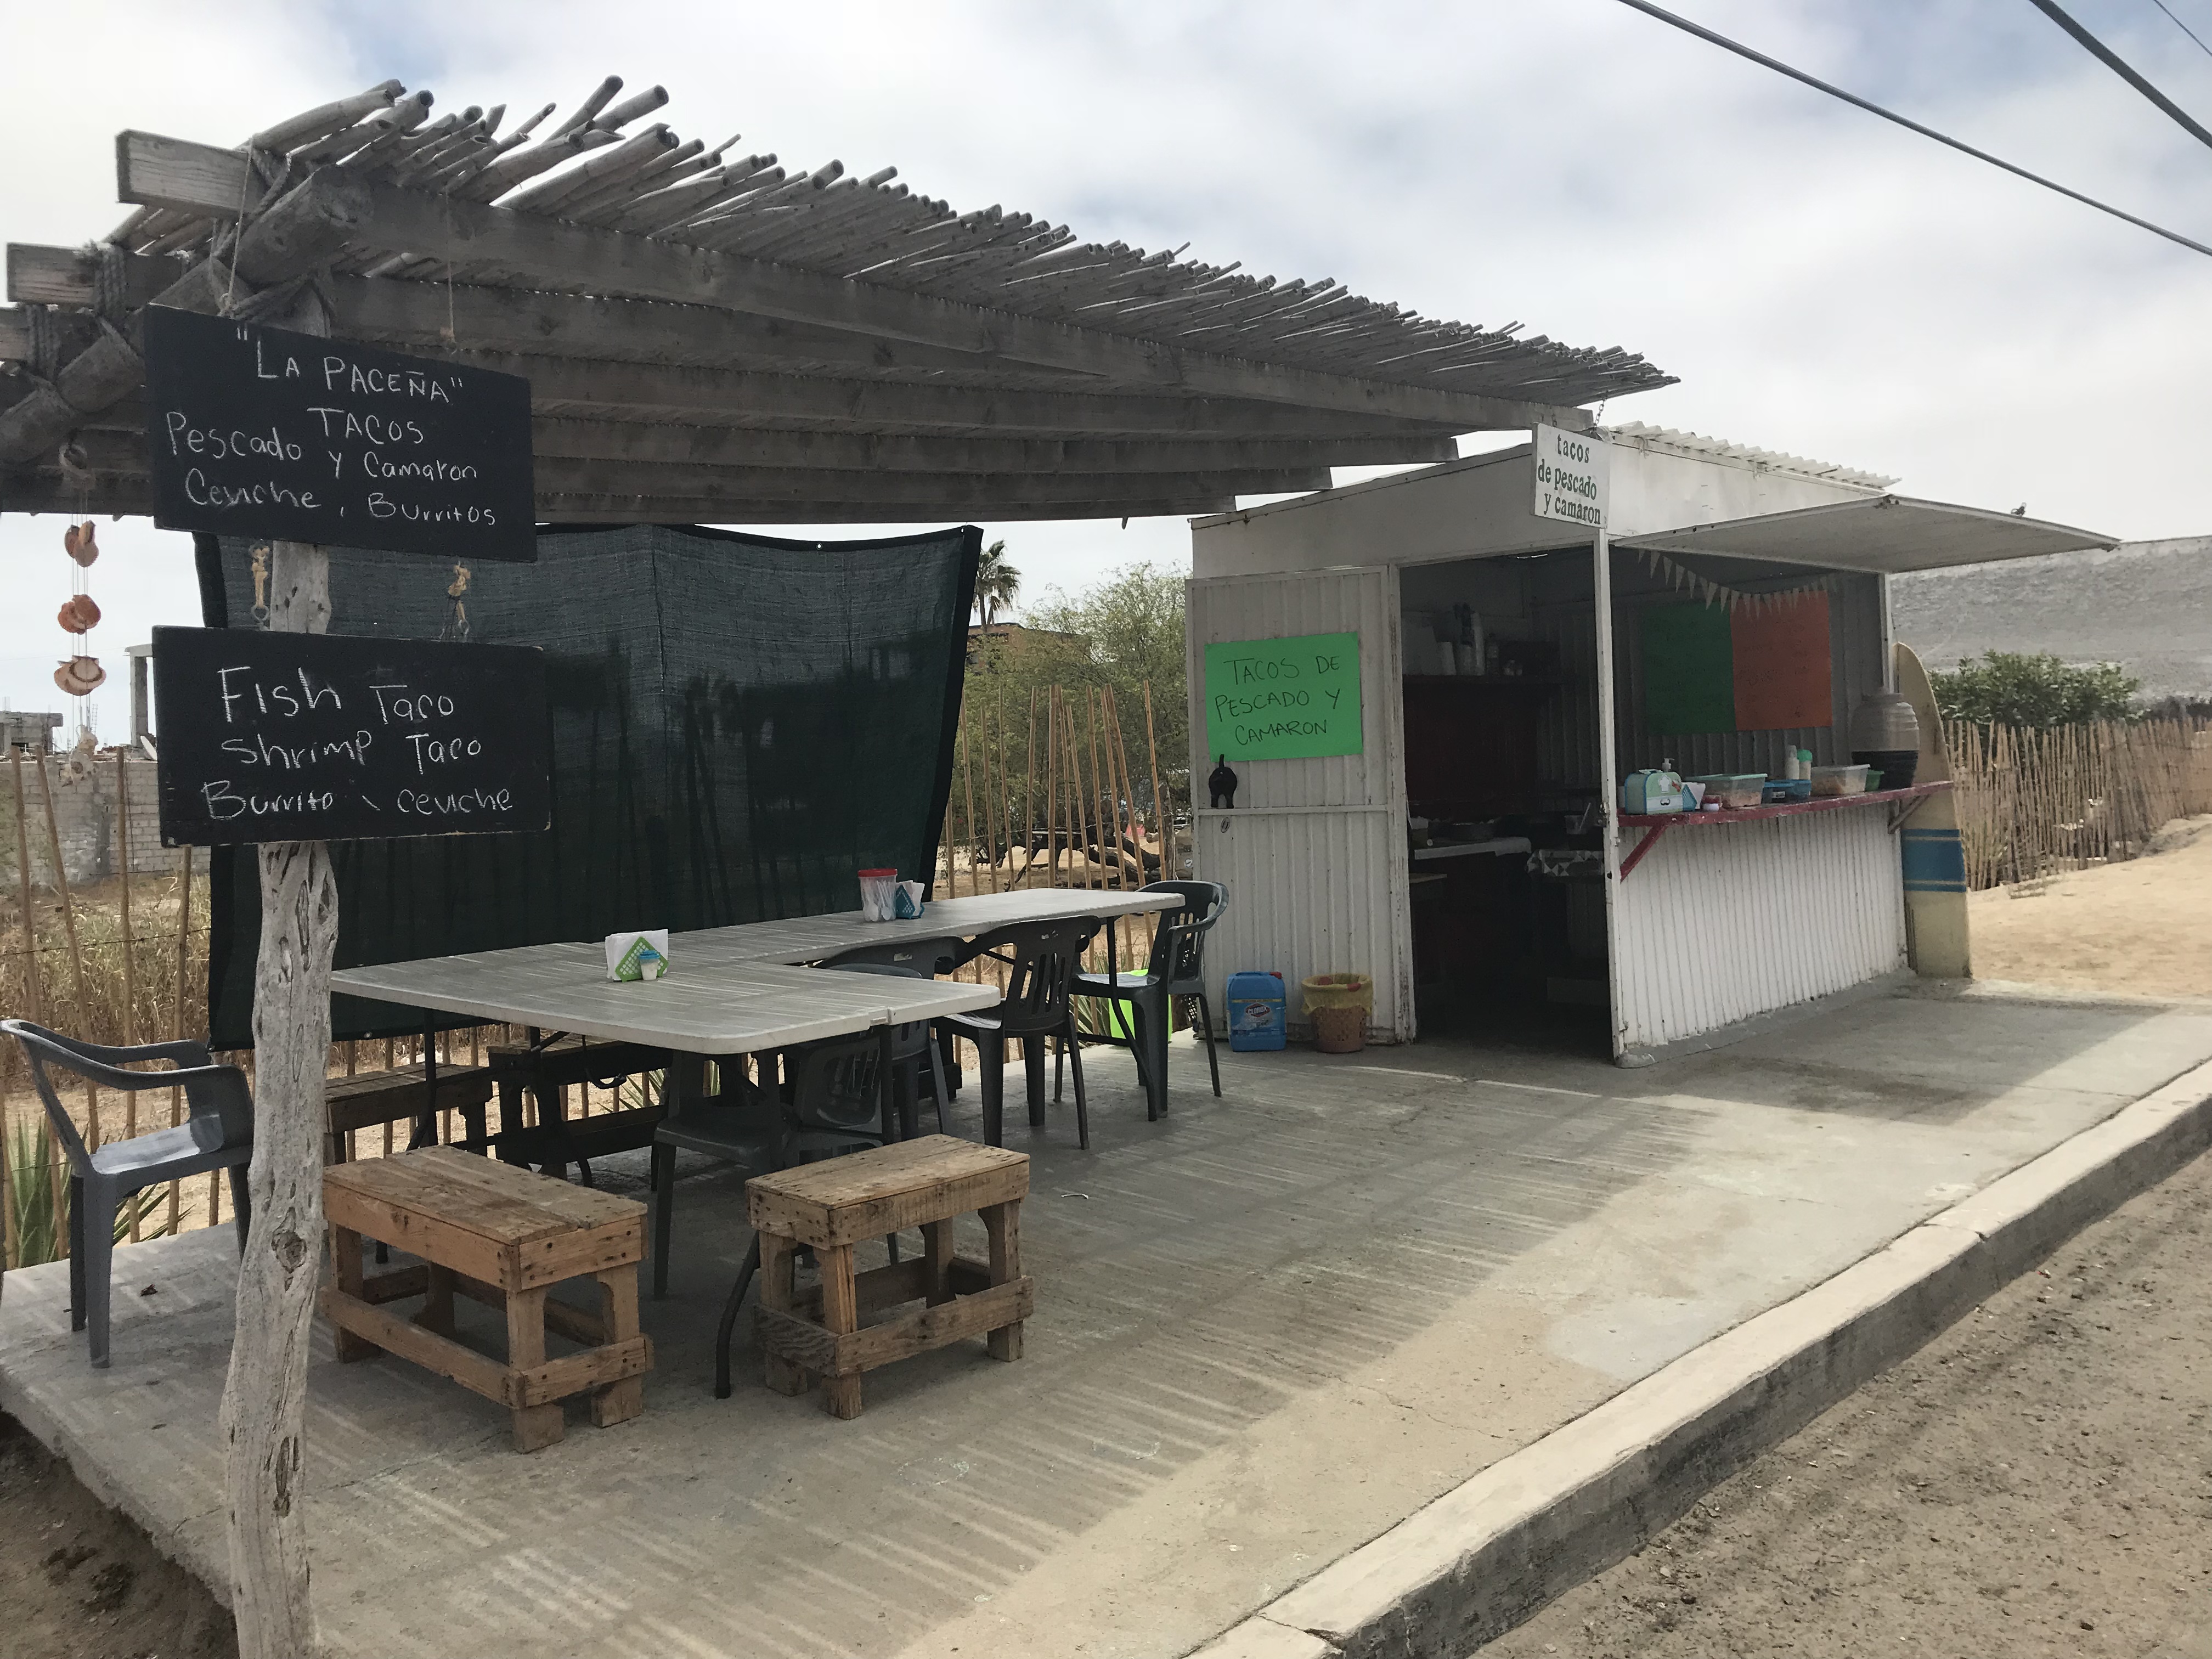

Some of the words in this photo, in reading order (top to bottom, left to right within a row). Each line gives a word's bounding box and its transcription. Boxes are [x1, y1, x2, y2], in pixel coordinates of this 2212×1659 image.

[307, 408, 424, 444] TACOS
[166, 411, 302, 461] Pescado
[363, 451, 477, 481] Camaron
[1557, 434, 1589, 464] tacos
[1538, 459, 1551, 483] de
[1554, 468, 1597, 500] pescado
[368, 492, 495, 526] Burritos
[1543, 493, 1551, 515] y
[1555, 496, 1601, 524] camaron
[1223, 658, 1300, 685] TACOS
[1315, 656, 1340, 674] DE
[369, 684, 454, 725] Taco
[1215, 690, 1310, 723] PESCADO
[1324, 688, 1340, 710] Y
[1235, 719, 1327, 746] CAMARON
[405, 732, 482, 775] Taco
[201, 780, 334, 820] Burrito
